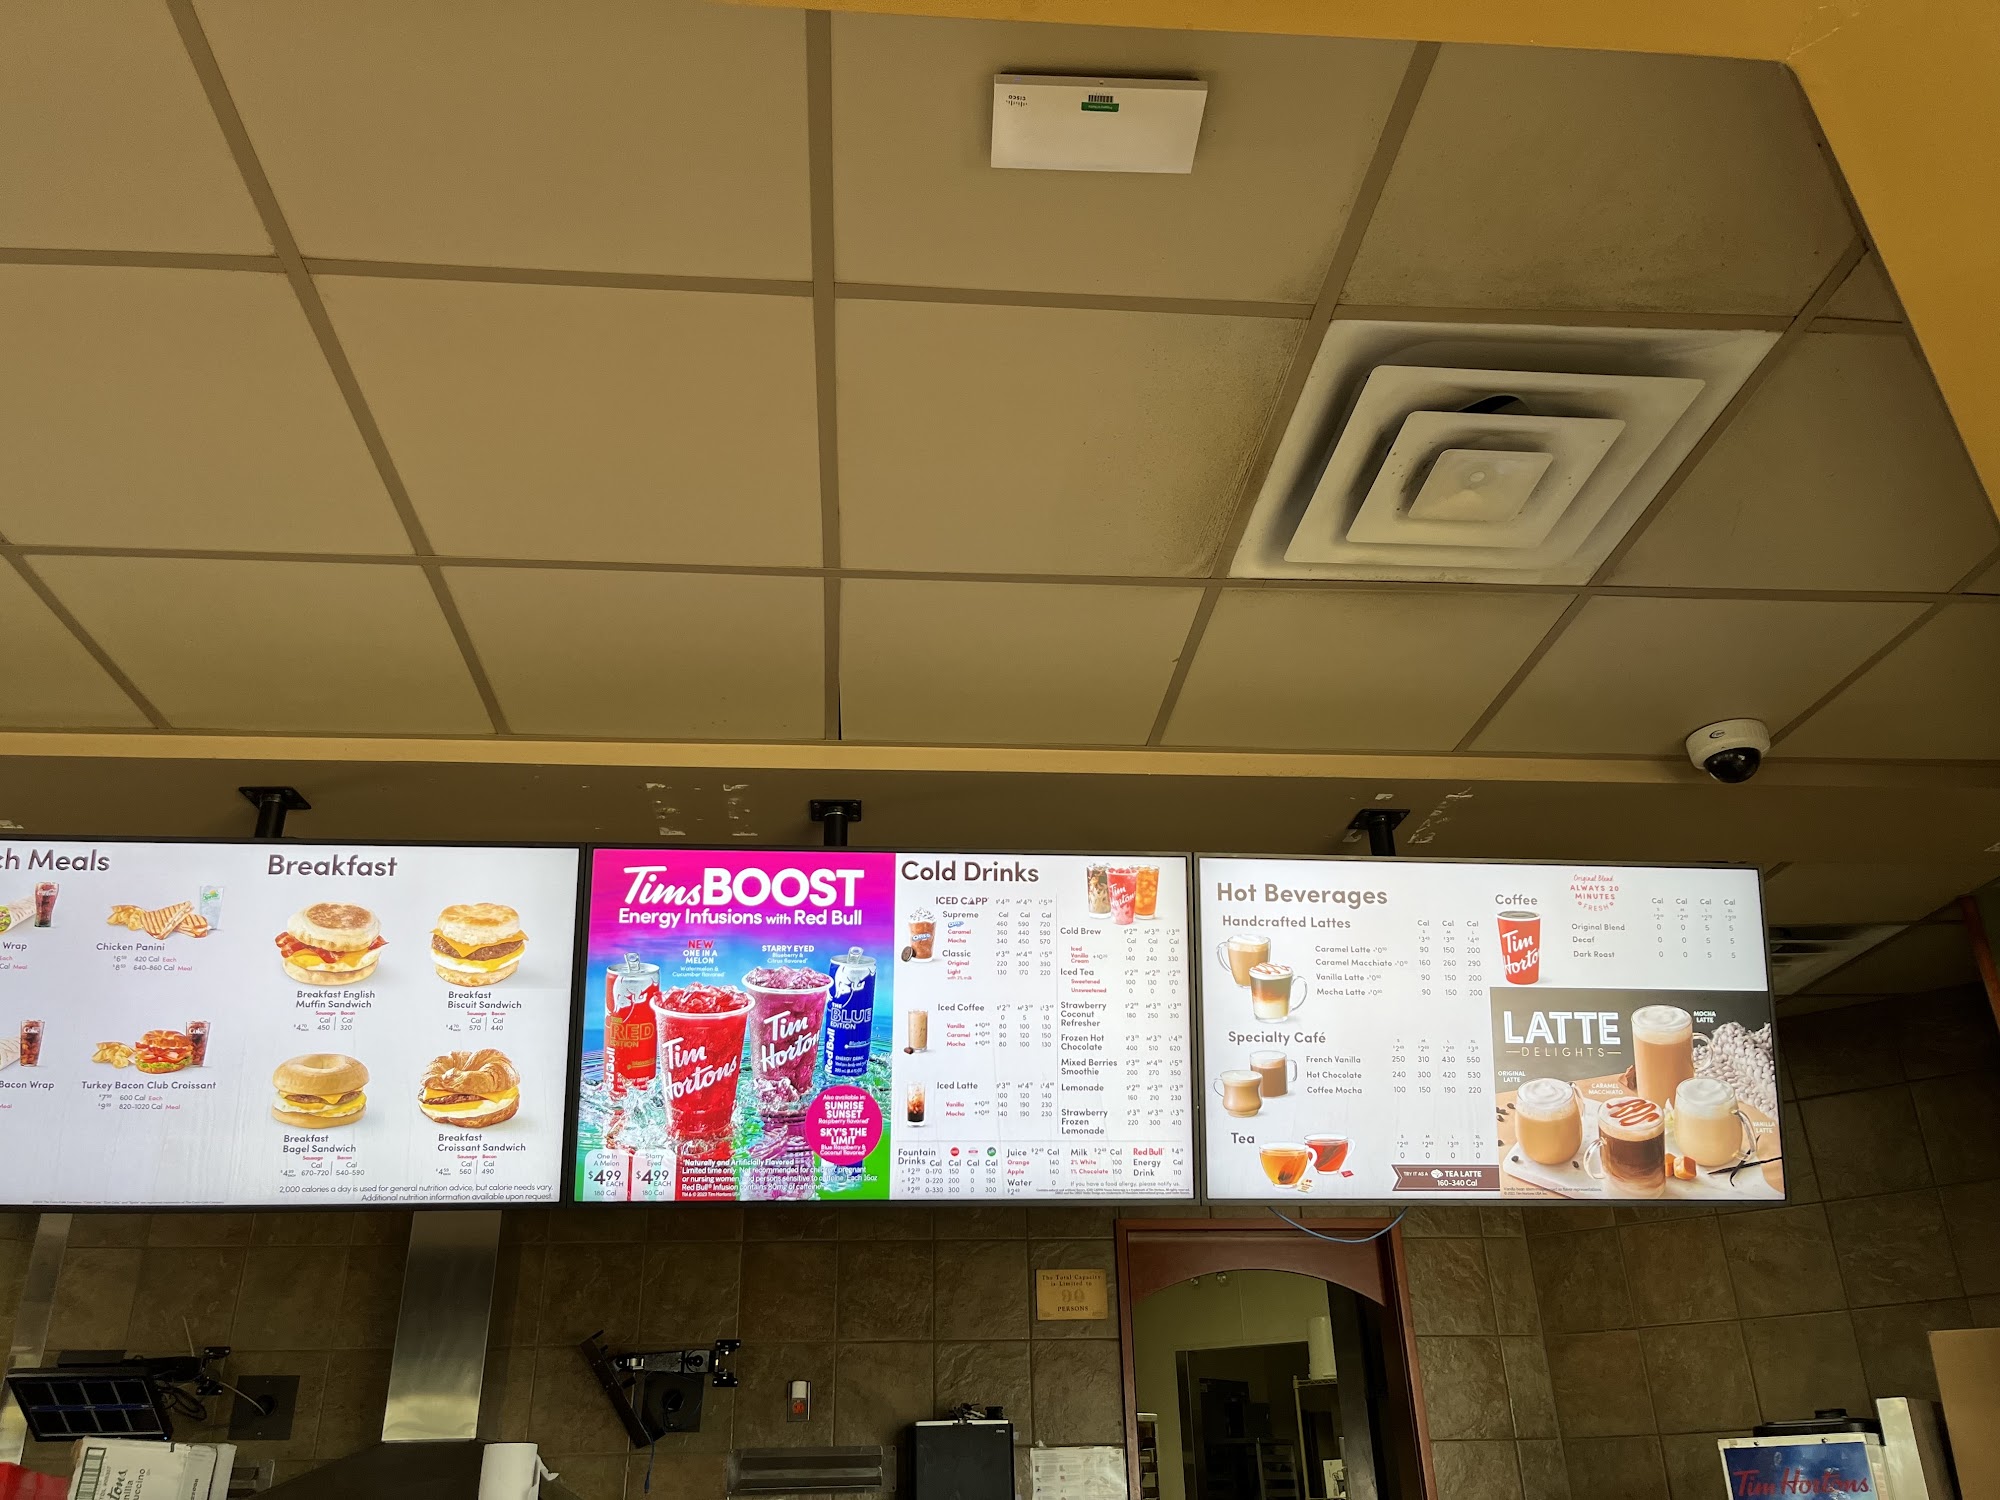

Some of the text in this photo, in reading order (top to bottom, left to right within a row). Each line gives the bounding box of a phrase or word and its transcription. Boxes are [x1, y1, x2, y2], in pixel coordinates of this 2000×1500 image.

[28, 849, 110, 872] Meals
[268, 854, 397, 878] Breakfast
[902, 861, 1039, 882] Cold Drinks
[624, 865, 864, 906] Tims BOOST
[1217, 883, 1387, 909] Hot Beverages
[1496, 894, 1538, 905] Coffee
[936, 897, 958, 905] ICED
[619, 909, 862, 928] Energy Infusions with Red Bull
[943, 911, 979, 919] Supreme
[1222, 915, 1351, 928] Handcrafted Lattes
[688, 940, 713, 949] NEW
[1502, 929, 1534, 954] Tim
[3, 942, 27, 951] Wrap
[96, 942, 165, 951] Chicken Panini
[1315, 945, 1348, 953] Caramel
[942, 950, 971, 958] Classic
[1351, 959, 1392, 967] Macchiato
[1061, 968, 1076, 976] Iced
[1345, 973, 1364, 981] Latte
[344, 991, 375, 999] English
[449, 991, 491, 999] Breakfast
[296, 1000, 372, 1008] Muffin Sandwich
[448, 1001, 521, 1009] Biscuit Sandwich
[1060, 1002, 1106, 1010] Strawberry
[831, 1006, 872, 1023] BLUE
[765, 1010, 808, 1041] Tim
[1061, 1019, 1100, 1027] Refresher
[1503, 1011, 1620, 1044] LATTE
[1228, 1031, 1326, 1044] Specialty Café
[1061, 1043, 1102, 1051] Chocolate
[662, 1038, 707, 1067] Tim
[1521, 1048, 1604, 1057] DELIGHTS
[1322, 1071, 1362, 1079] Chocolate
[0, 1081, 55, 1090] Bacon Wrap
[82, 1081, 216, 1091] Turkey Bacon Club Croissant
[825, 1102, 863, 1110] SUNRISE
[827, 1110, 861, 1118] SUNSET
[1062, 1109, 1108, 1117] Strawberry
[1061, 1118, 1089, 1126] Frozen
[821, 1128, 847, 1136] SKY'S
[1062, 1127, 1104, 1135] Lemonade
[831, 1136, 855, 1145] LIMIT
[1231, 1132, 1255, 1144] Tea
[283, 1145, 356, 1154] Bagel Sandwich
[438, 1144, 480, 1152] Croissant
[898, 1148, 936, 1156] Fountain
[1007, 1149, 1026, 1157] Juice
[898, 1157, 925, 1165] Drinks
[1133, 1159, 1160, 1167] Energy
[337, 1185, 351, 1193] day
[390, 1185, 417, 1193] general
[1056, 1273, 1072, 1281] Total
[1733, 1469, 1776, 1497] Tim
